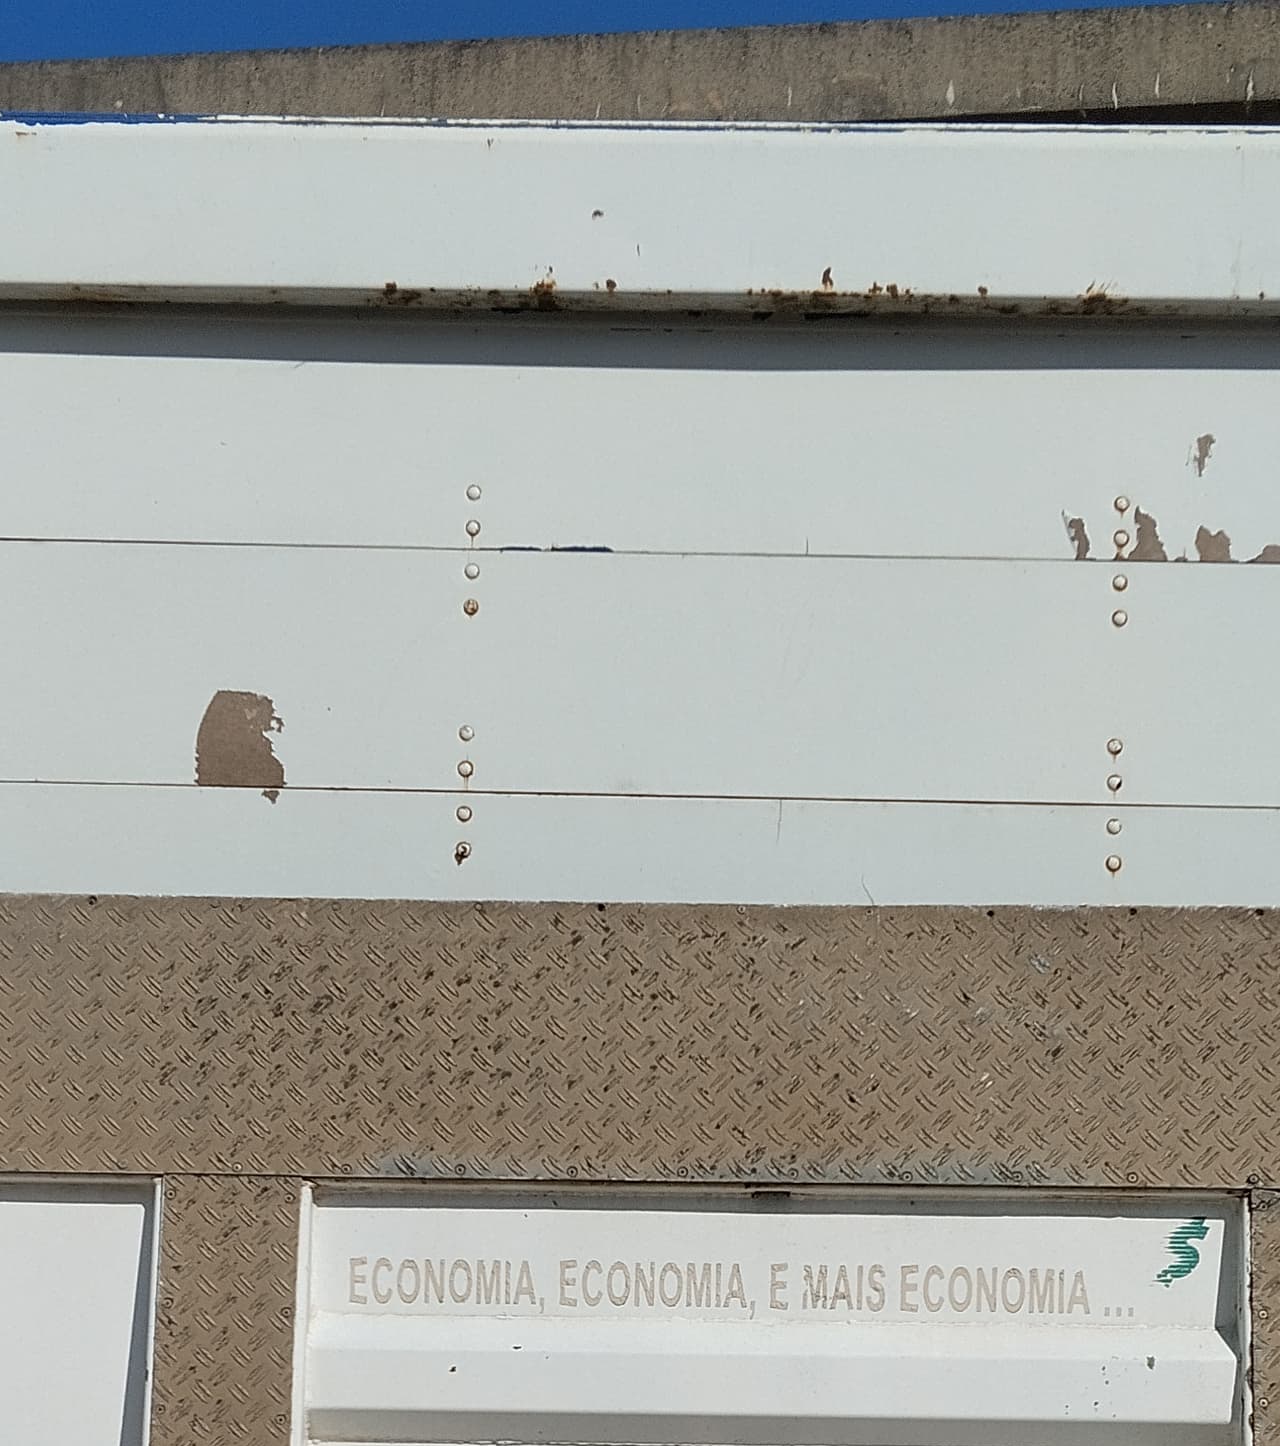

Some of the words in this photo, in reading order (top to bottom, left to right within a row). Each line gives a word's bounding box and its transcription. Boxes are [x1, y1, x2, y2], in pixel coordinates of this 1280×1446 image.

[349, 1256, 545, 1313] ECONOMIA,
[560, 1259, 756, 1319] ECONOMIA,
[769, 1263, 789, 1311] E
[802, 1263, 886, 1312] MAIS
[900, 1265, 1091, 1315] ECONOMIA
